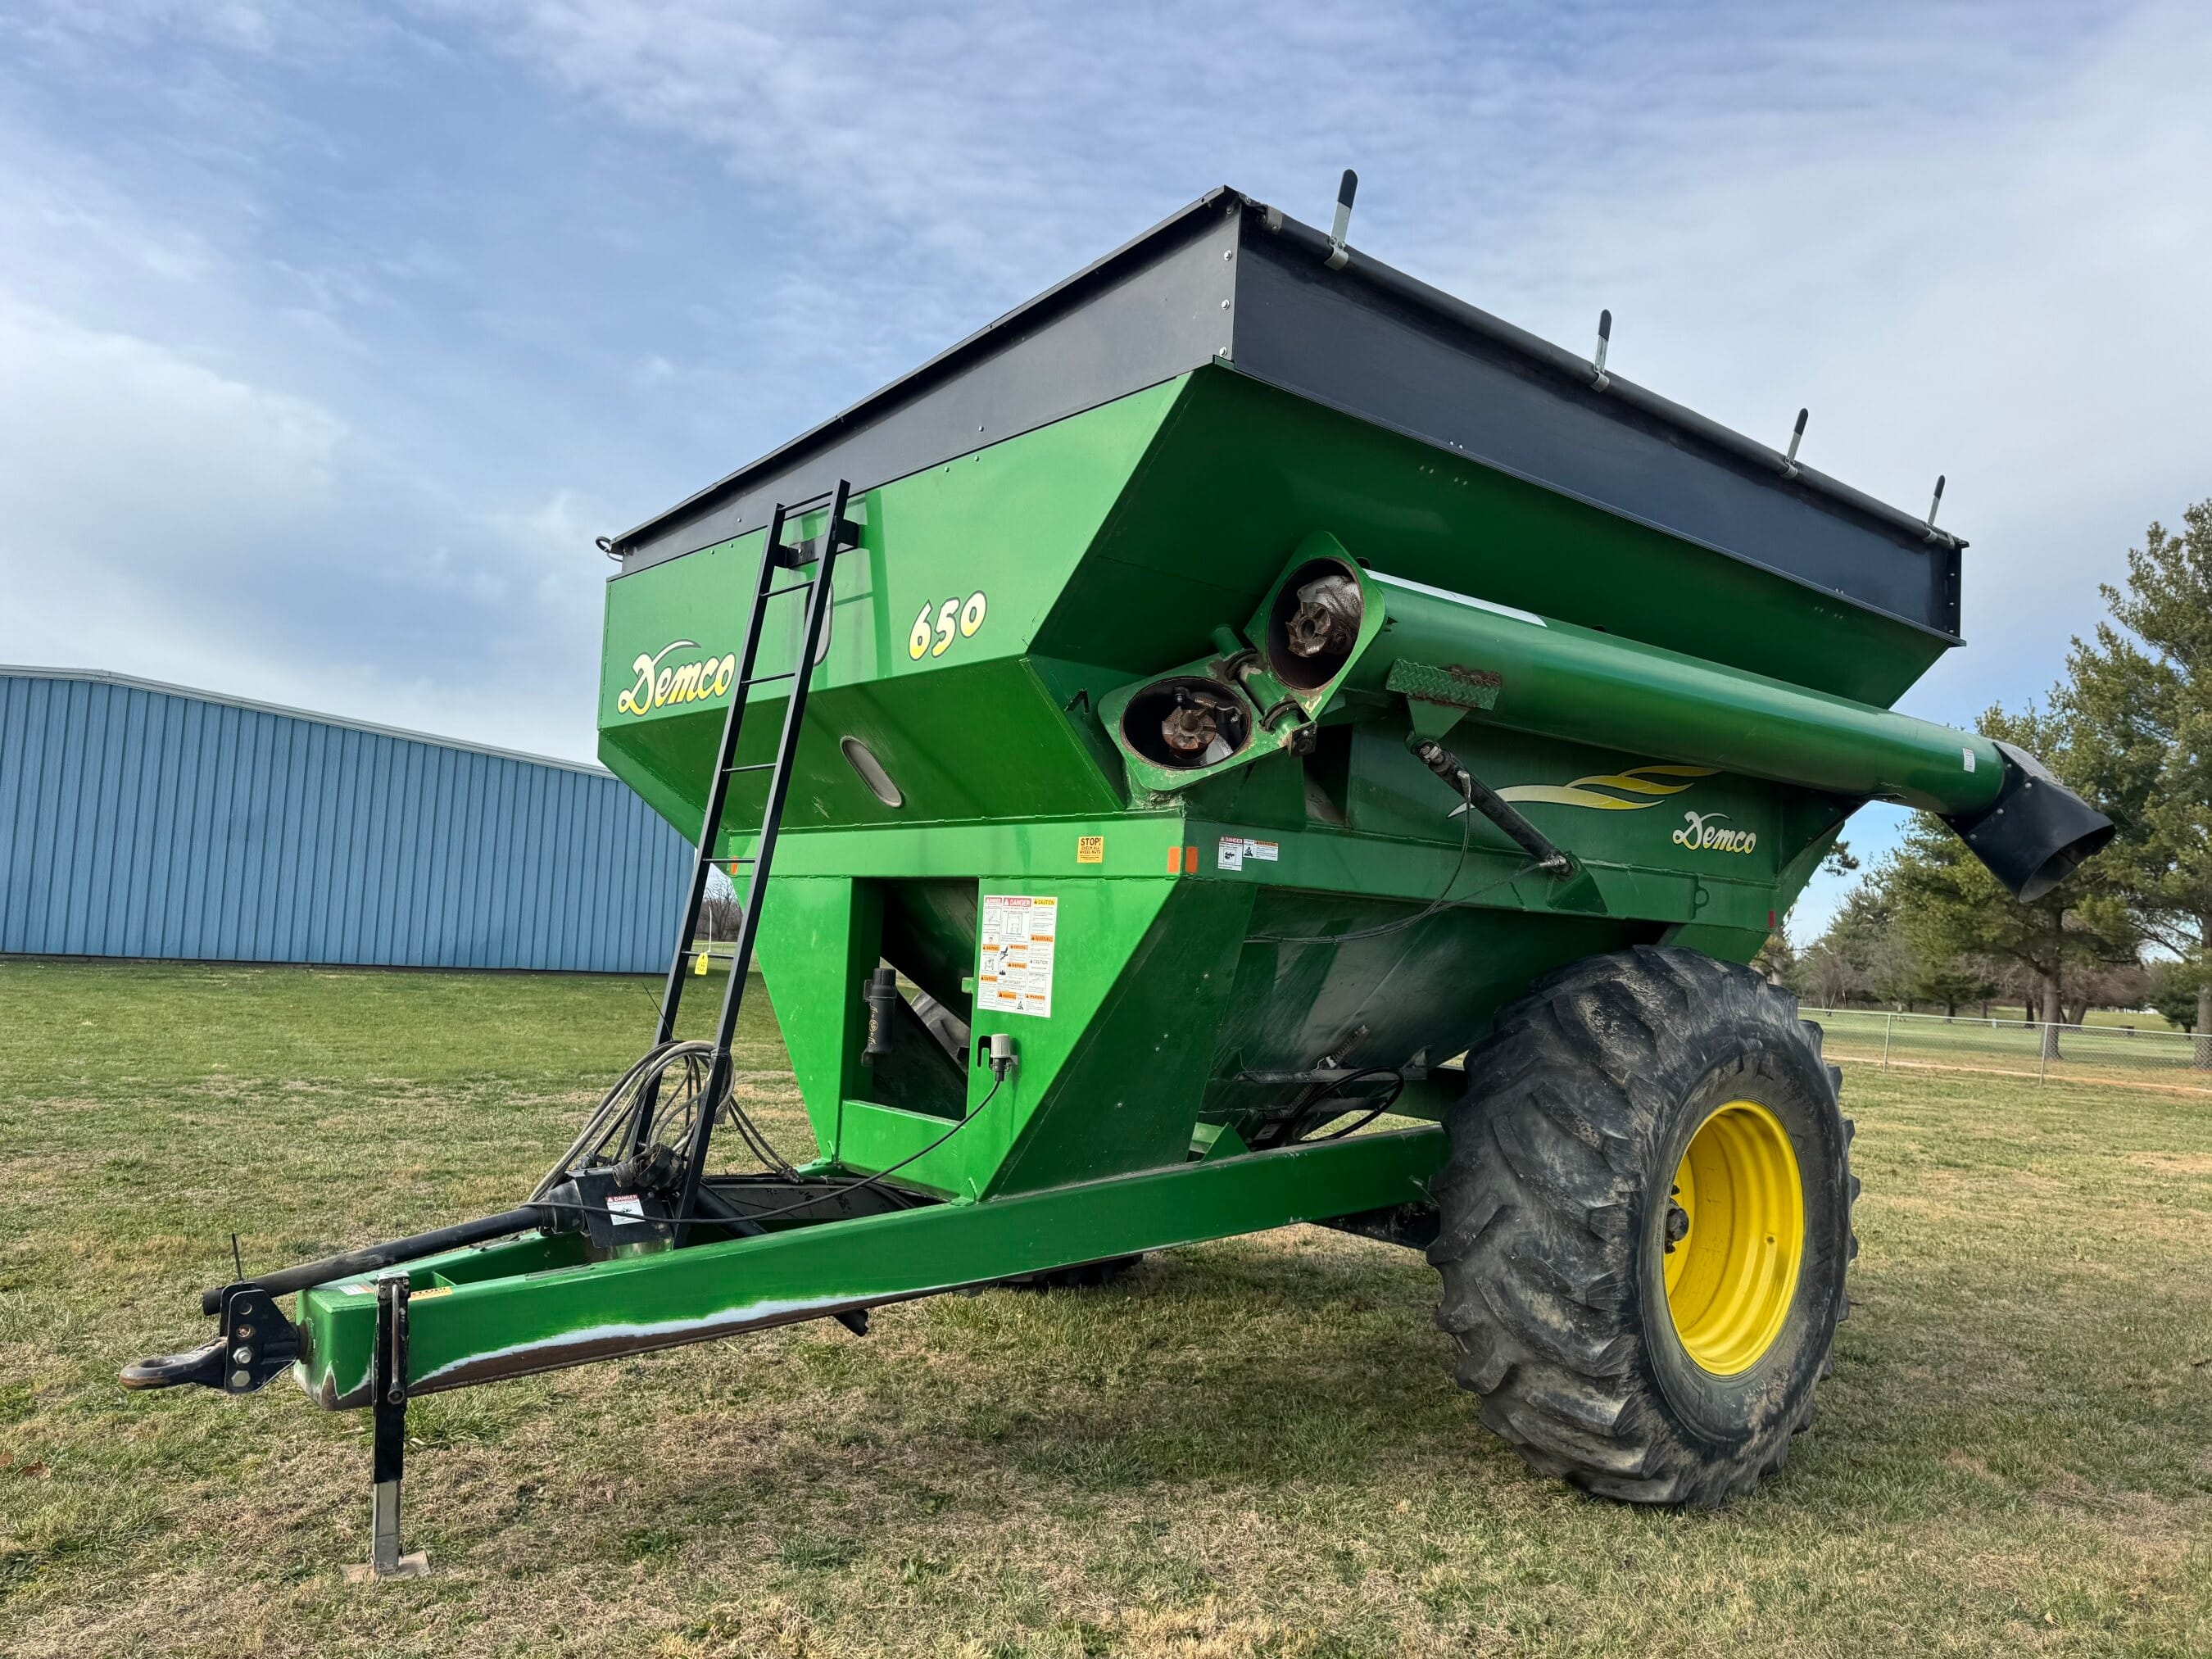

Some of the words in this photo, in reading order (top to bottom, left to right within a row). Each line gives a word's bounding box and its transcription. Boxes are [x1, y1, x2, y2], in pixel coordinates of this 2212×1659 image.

[909, 590, 987, 661] 650
[617, 639, 736, 716] Demco
[1081, 837, 1102, 846] STOP!
[1672, 810, 1757, 854] Demco
[1009, 899, 1031, 907] DANGER
